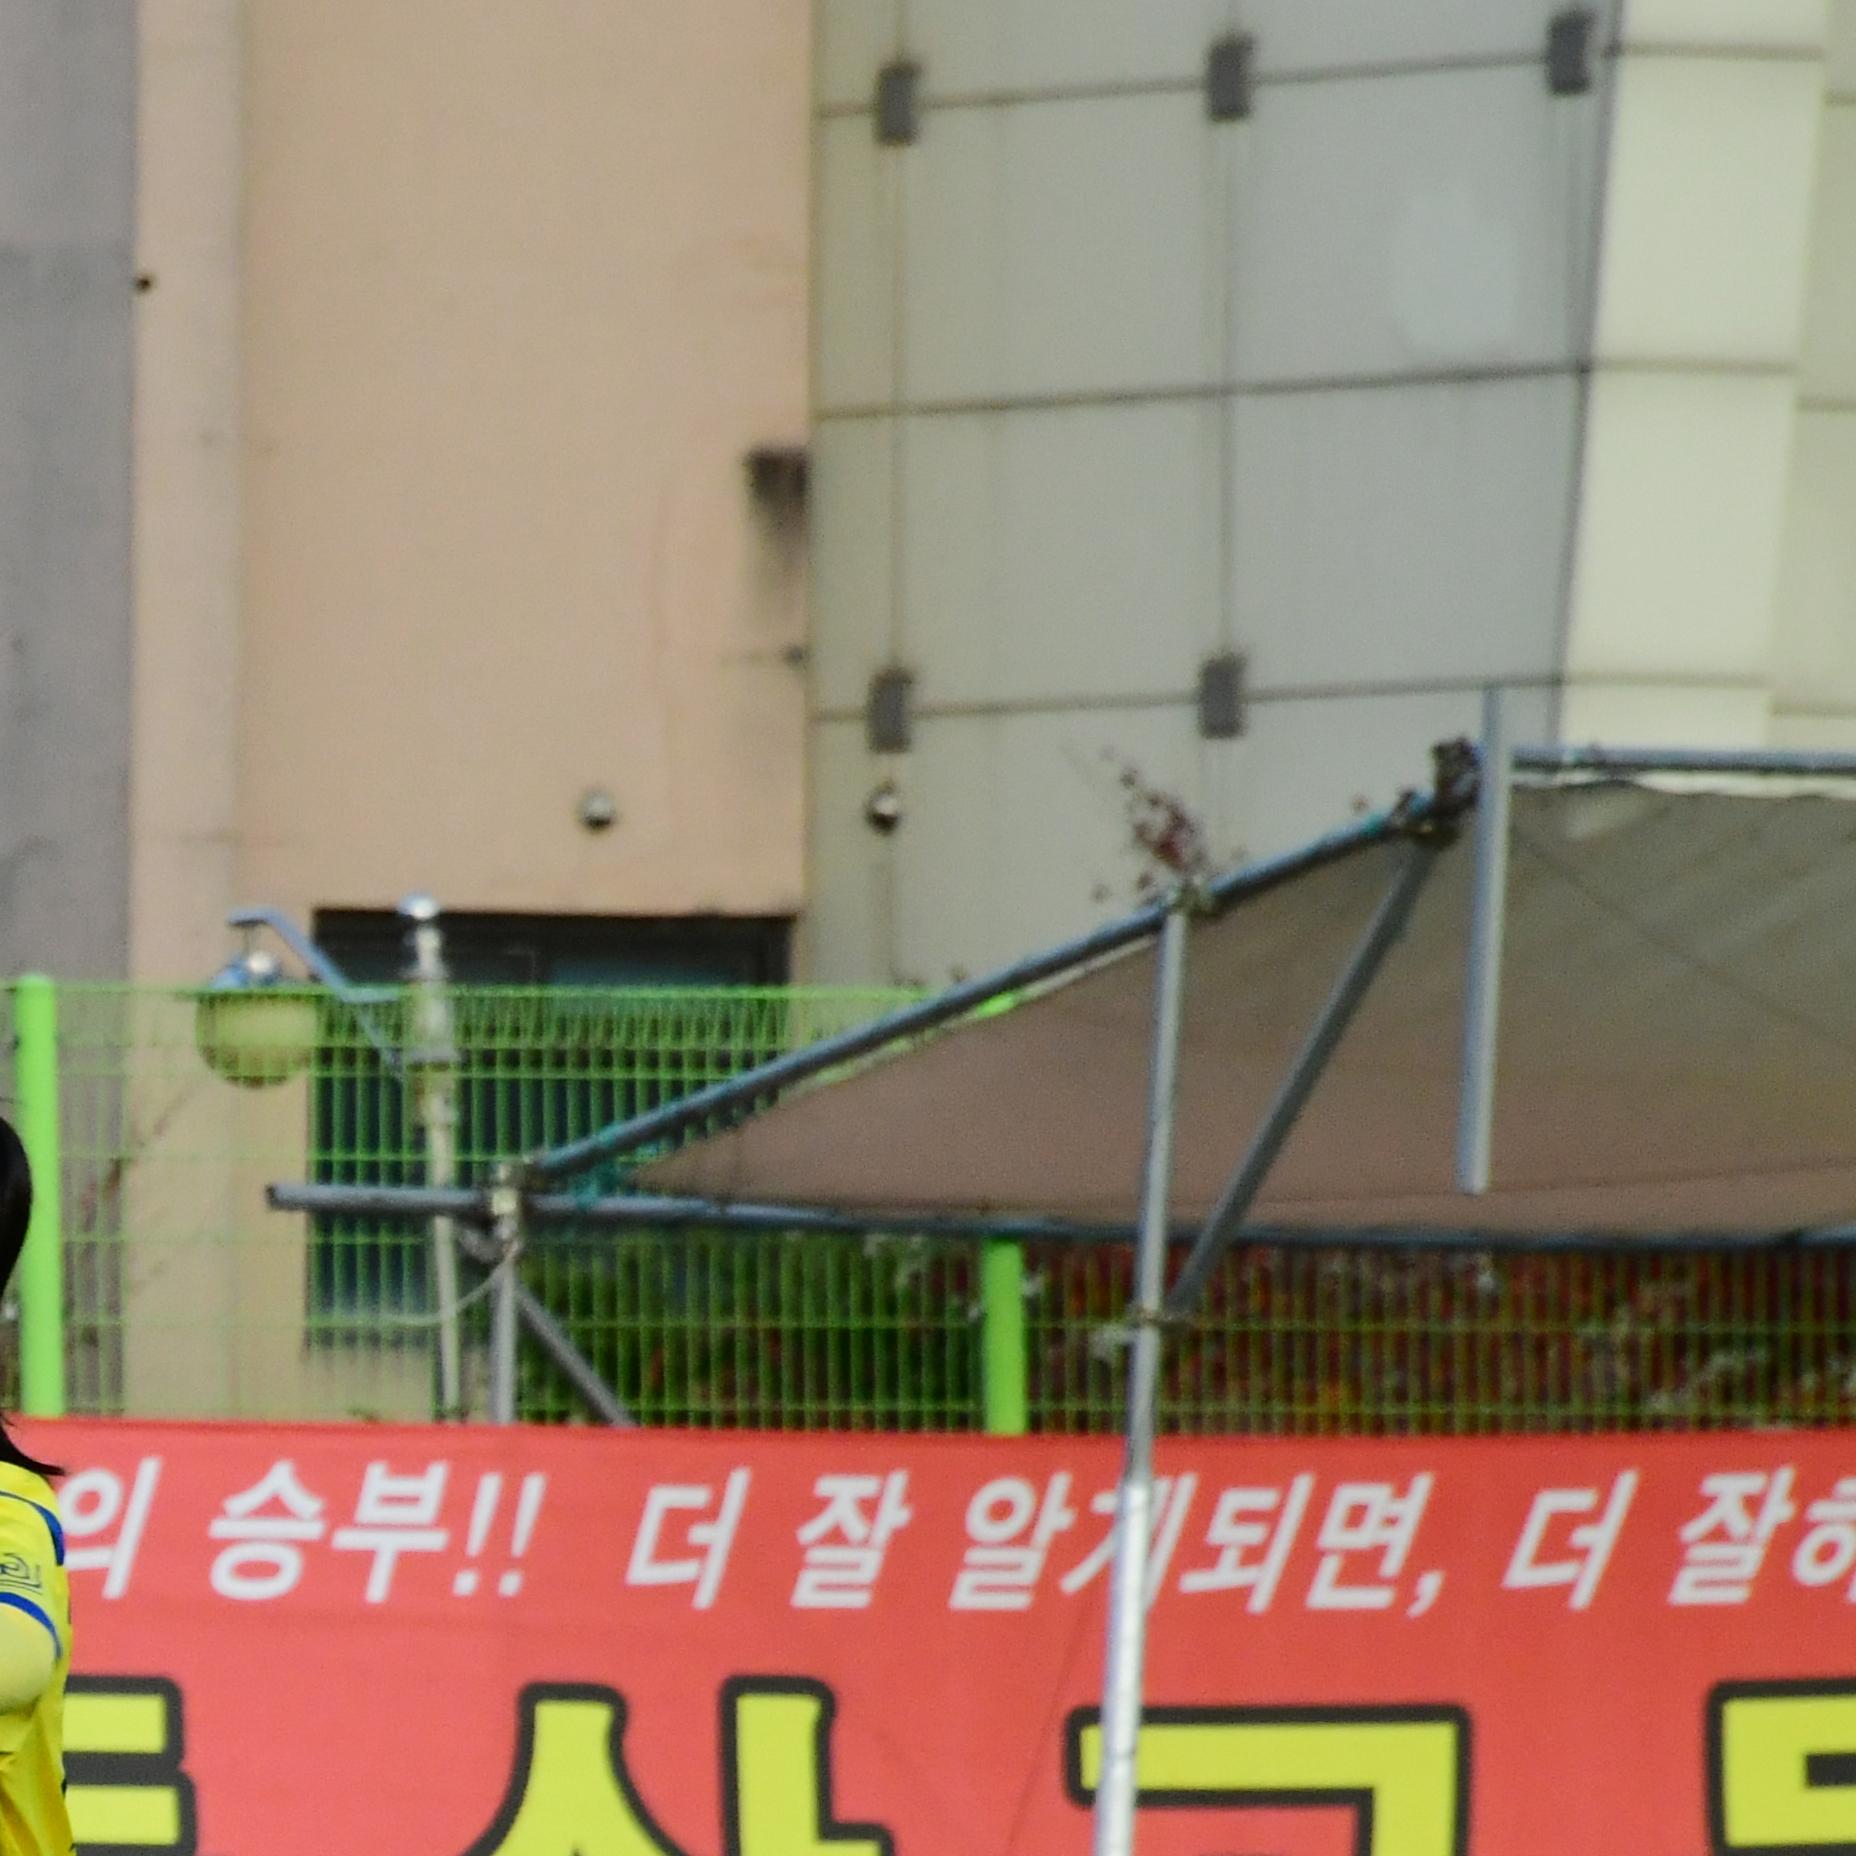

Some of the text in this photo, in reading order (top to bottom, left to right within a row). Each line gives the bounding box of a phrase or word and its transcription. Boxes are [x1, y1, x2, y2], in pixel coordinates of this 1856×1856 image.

[208, 1459, 550, 1605] 승부!!
[626, 1467, 752, 1610] 더
[790, 1469, 913, 1610] 잘
[1502, 1468, 1638, 1611] 더
